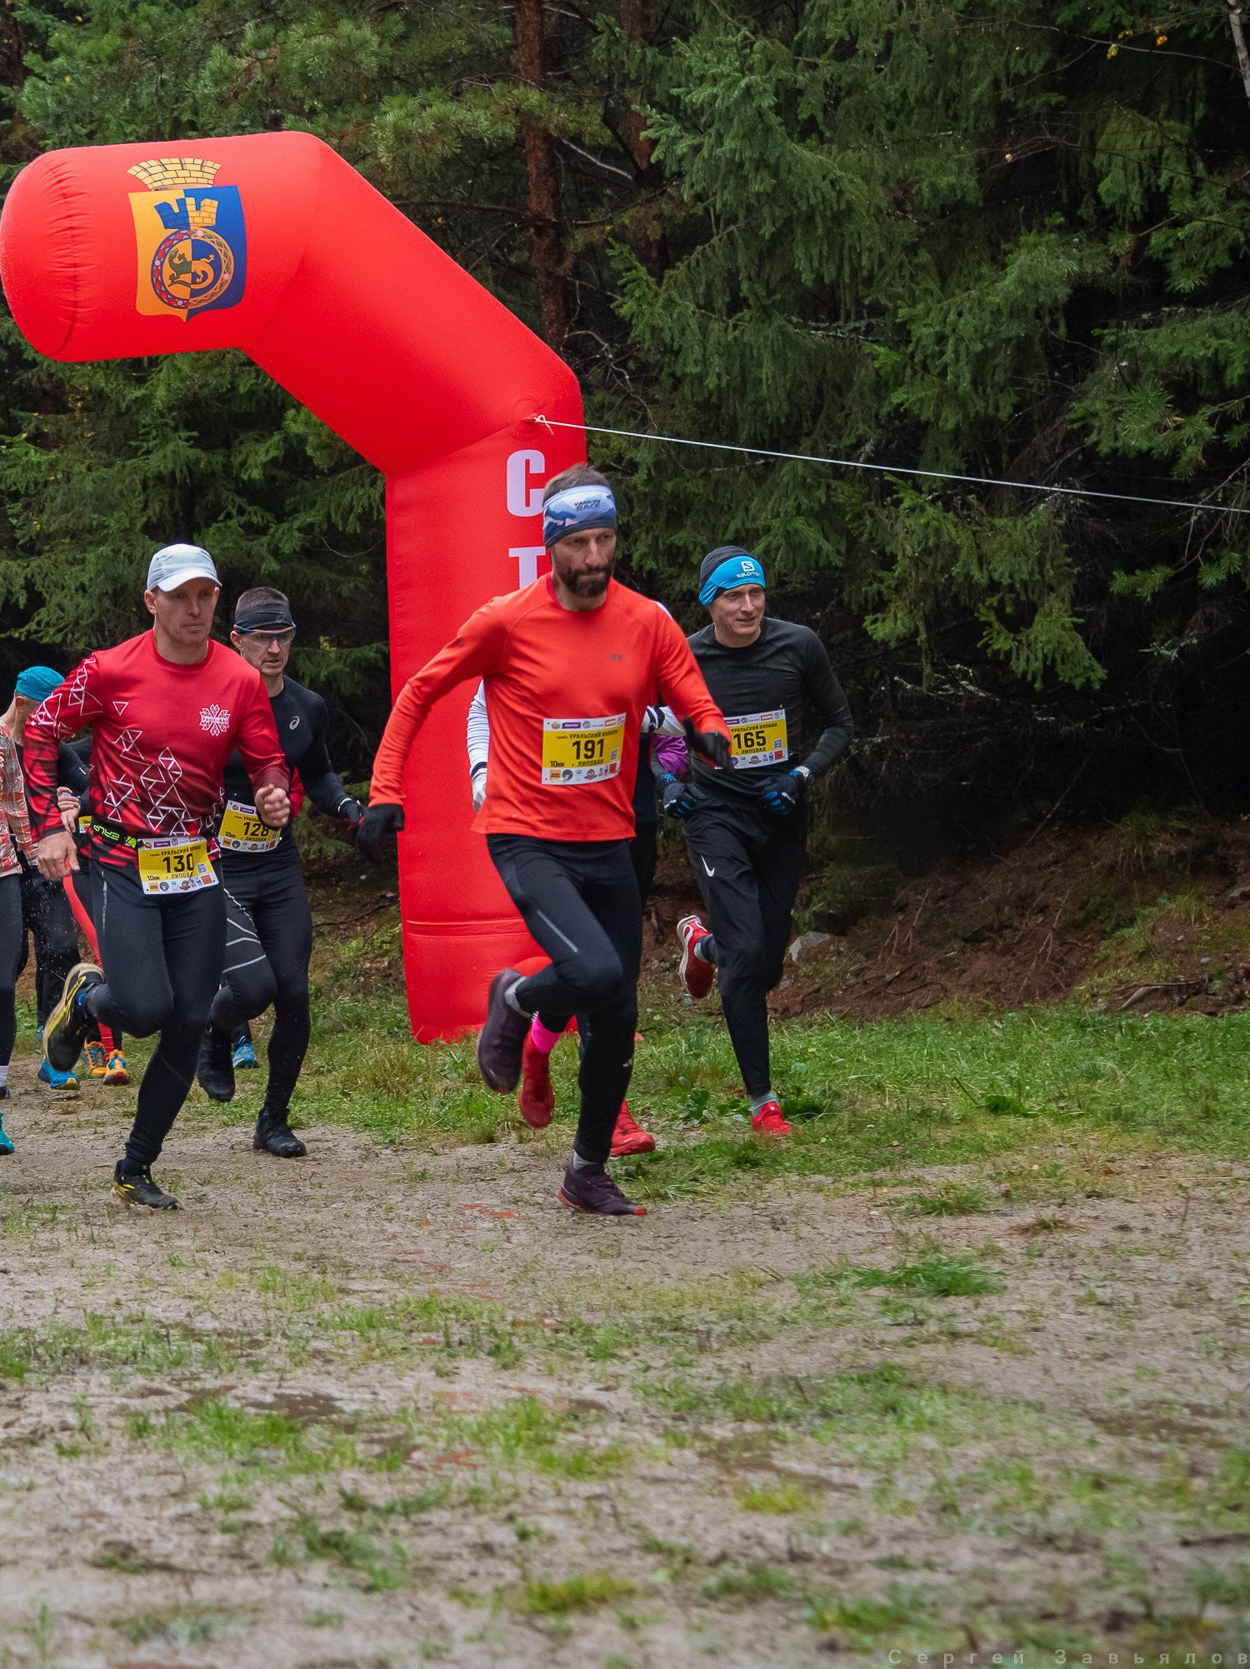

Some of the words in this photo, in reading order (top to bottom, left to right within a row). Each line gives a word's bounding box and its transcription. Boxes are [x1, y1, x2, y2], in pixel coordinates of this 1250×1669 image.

[572, 738, 605, 760] 191
[733, 730, 767, 750] 165
[243, 822, 269, 837] 128
[162, 853, 195, 873] 130
